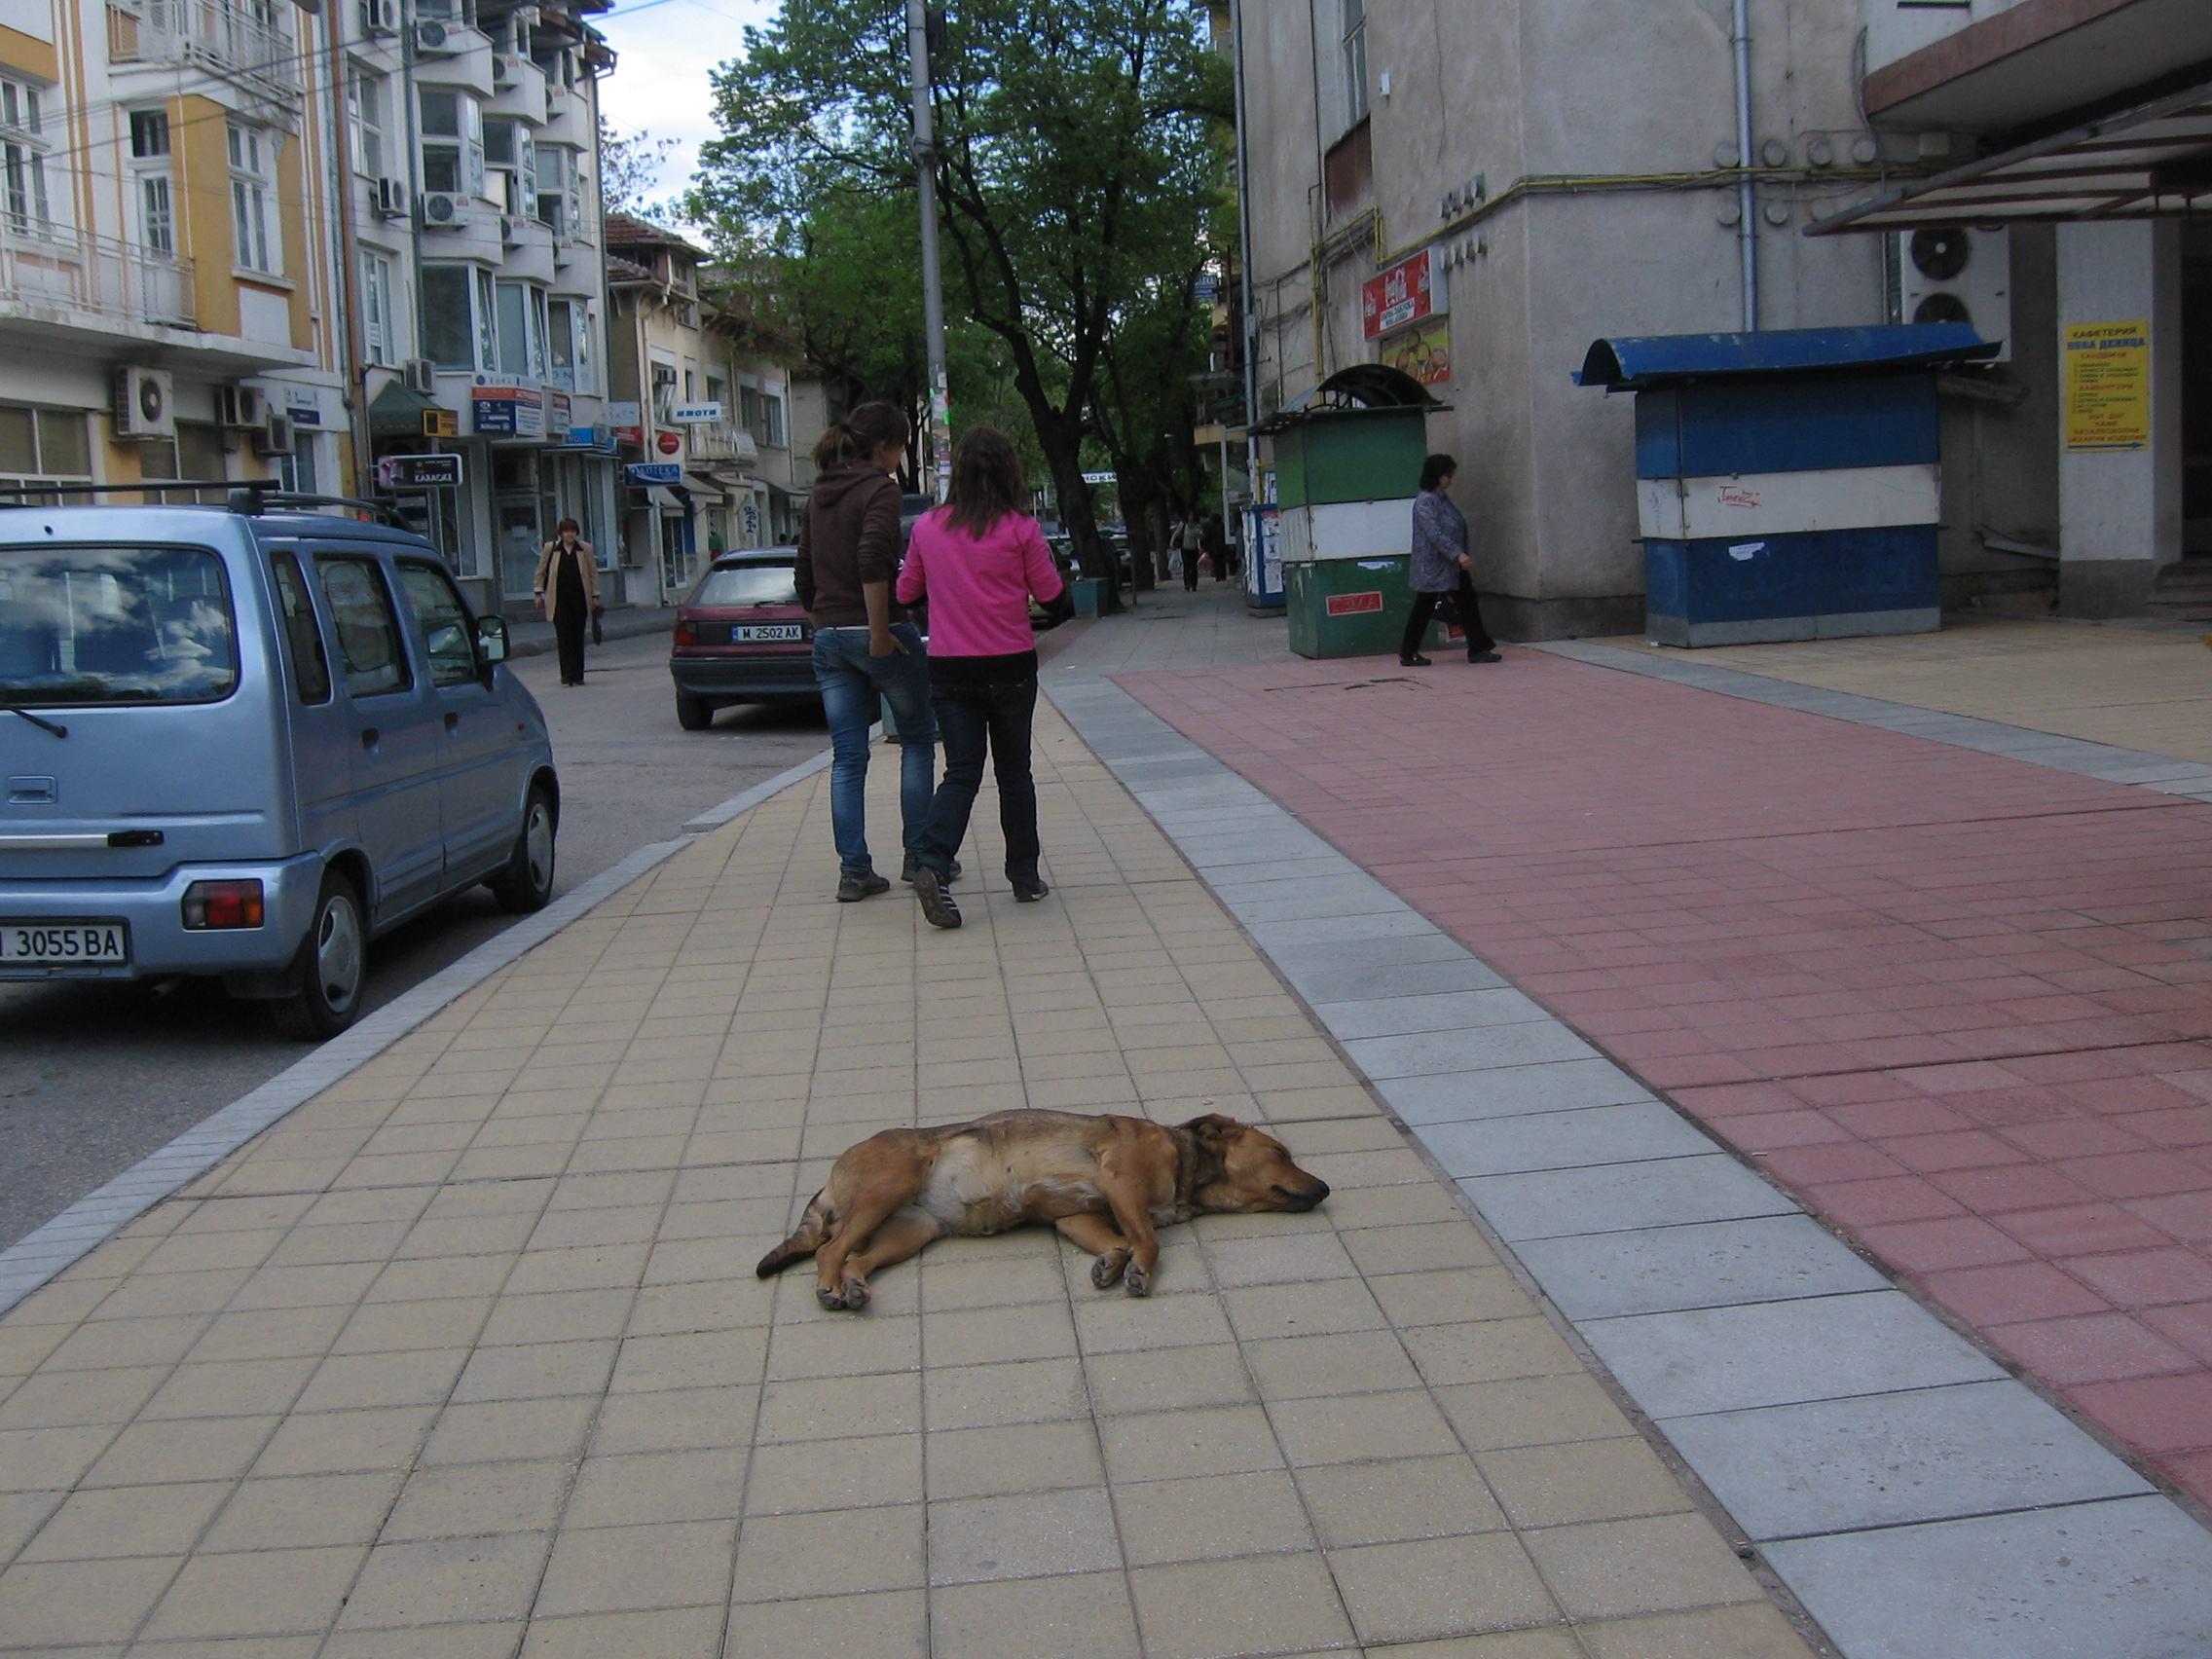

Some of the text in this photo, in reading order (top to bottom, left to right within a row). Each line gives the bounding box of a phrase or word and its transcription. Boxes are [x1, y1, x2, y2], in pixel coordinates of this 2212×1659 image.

[2072, 326, 2136, 338] КАФЕТЕРИЯ
[414, 473, 452, 483] KARAOKE
[756, 627, 783, 639] 2502
[786, 626, 799, 638] AK
[17, 930, 80, 956] 3055
[85, 929, 119, 956] BA
